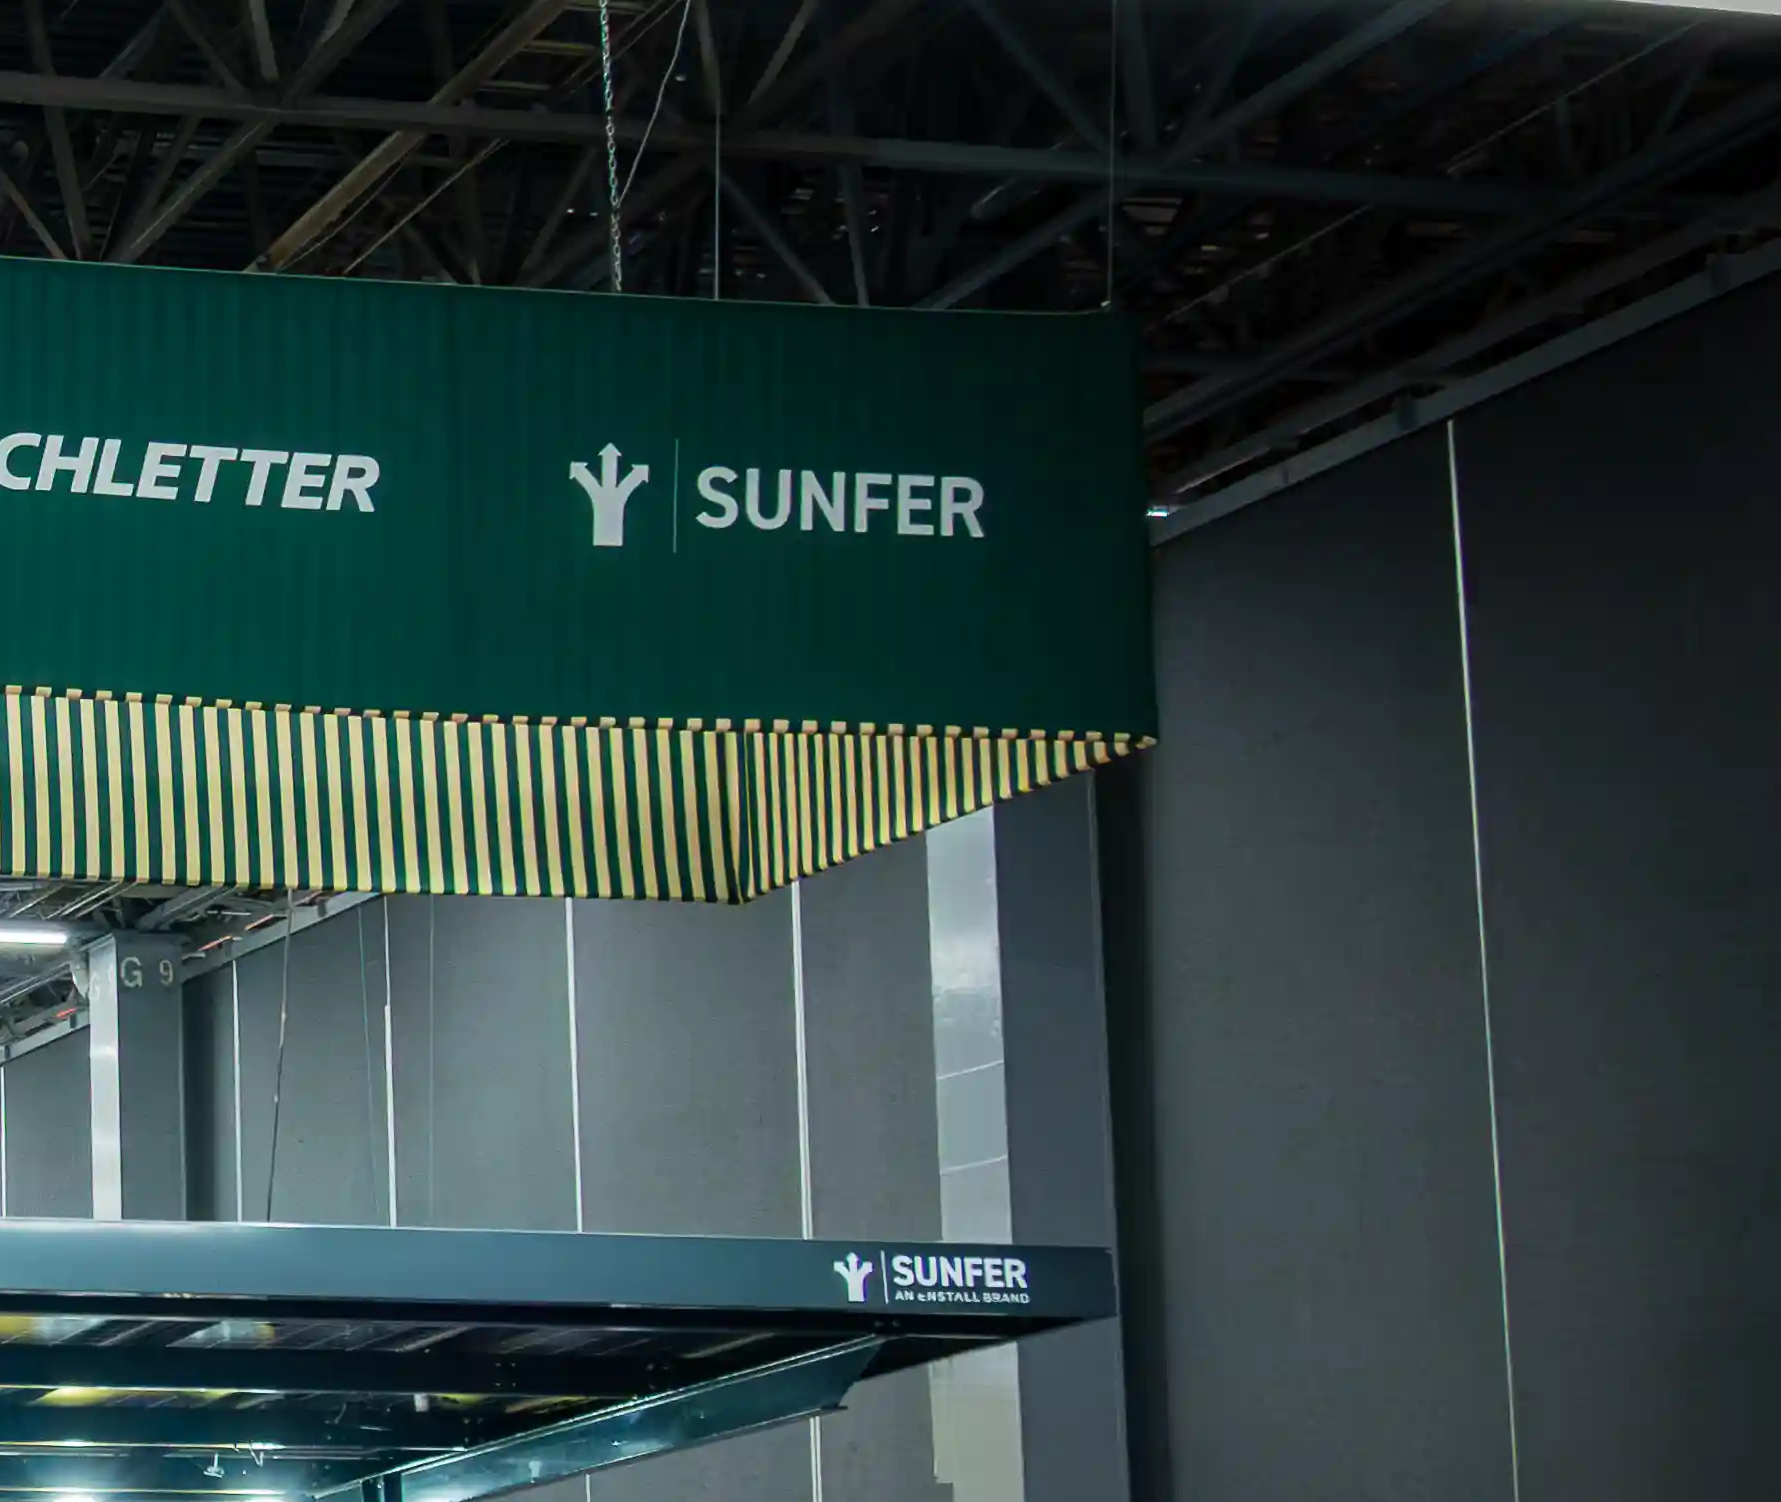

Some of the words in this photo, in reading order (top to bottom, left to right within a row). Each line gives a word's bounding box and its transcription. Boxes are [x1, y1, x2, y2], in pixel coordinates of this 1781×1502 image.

[695, 464, 987, 541] SUNFER
[120, 956, 143, 988] G
[159, 959, 174, 986] 9
[891, 1254, 1028, 1289] SUNFER
[894, 1290, 915, 1301] AN
[982, 1292, 1030, 1304] BRAND
